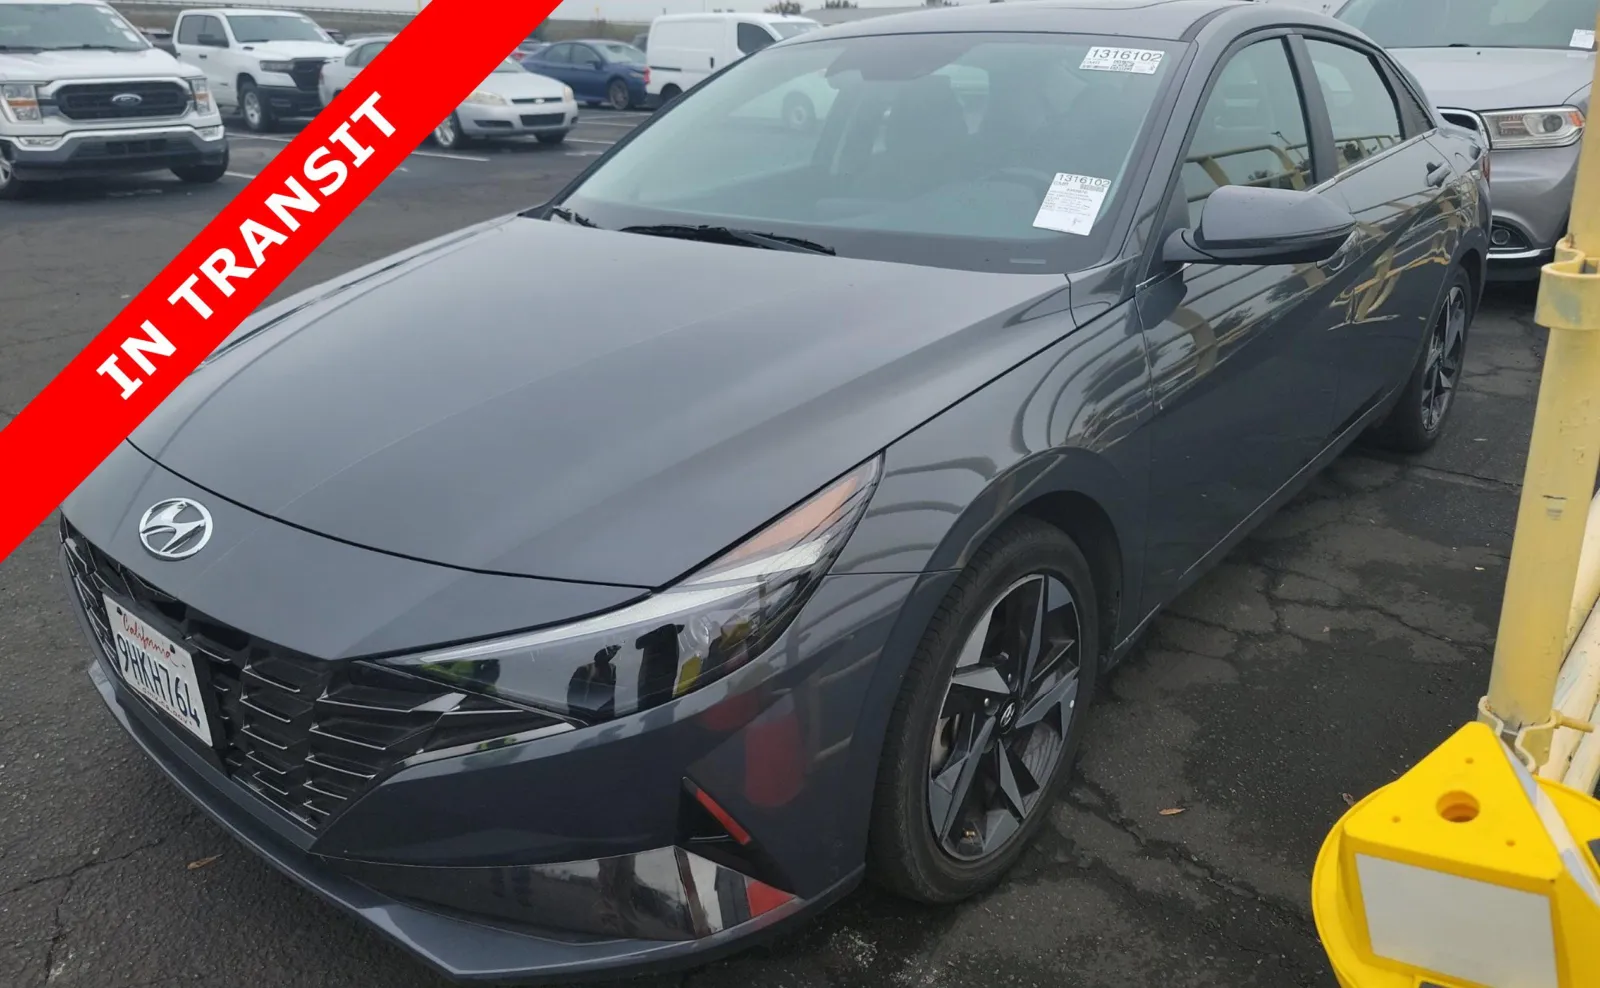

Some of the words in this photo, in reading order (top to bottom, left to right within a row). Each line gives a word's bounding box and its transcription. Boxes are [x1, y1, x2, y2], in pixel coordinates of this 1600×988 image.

[1092, 49, 1163, 62] 1316102
[1060, 174, 1111, 187] 1316102
[122, 613, 173, 661] California
[117, 633, 201, 727] 9HKH764
